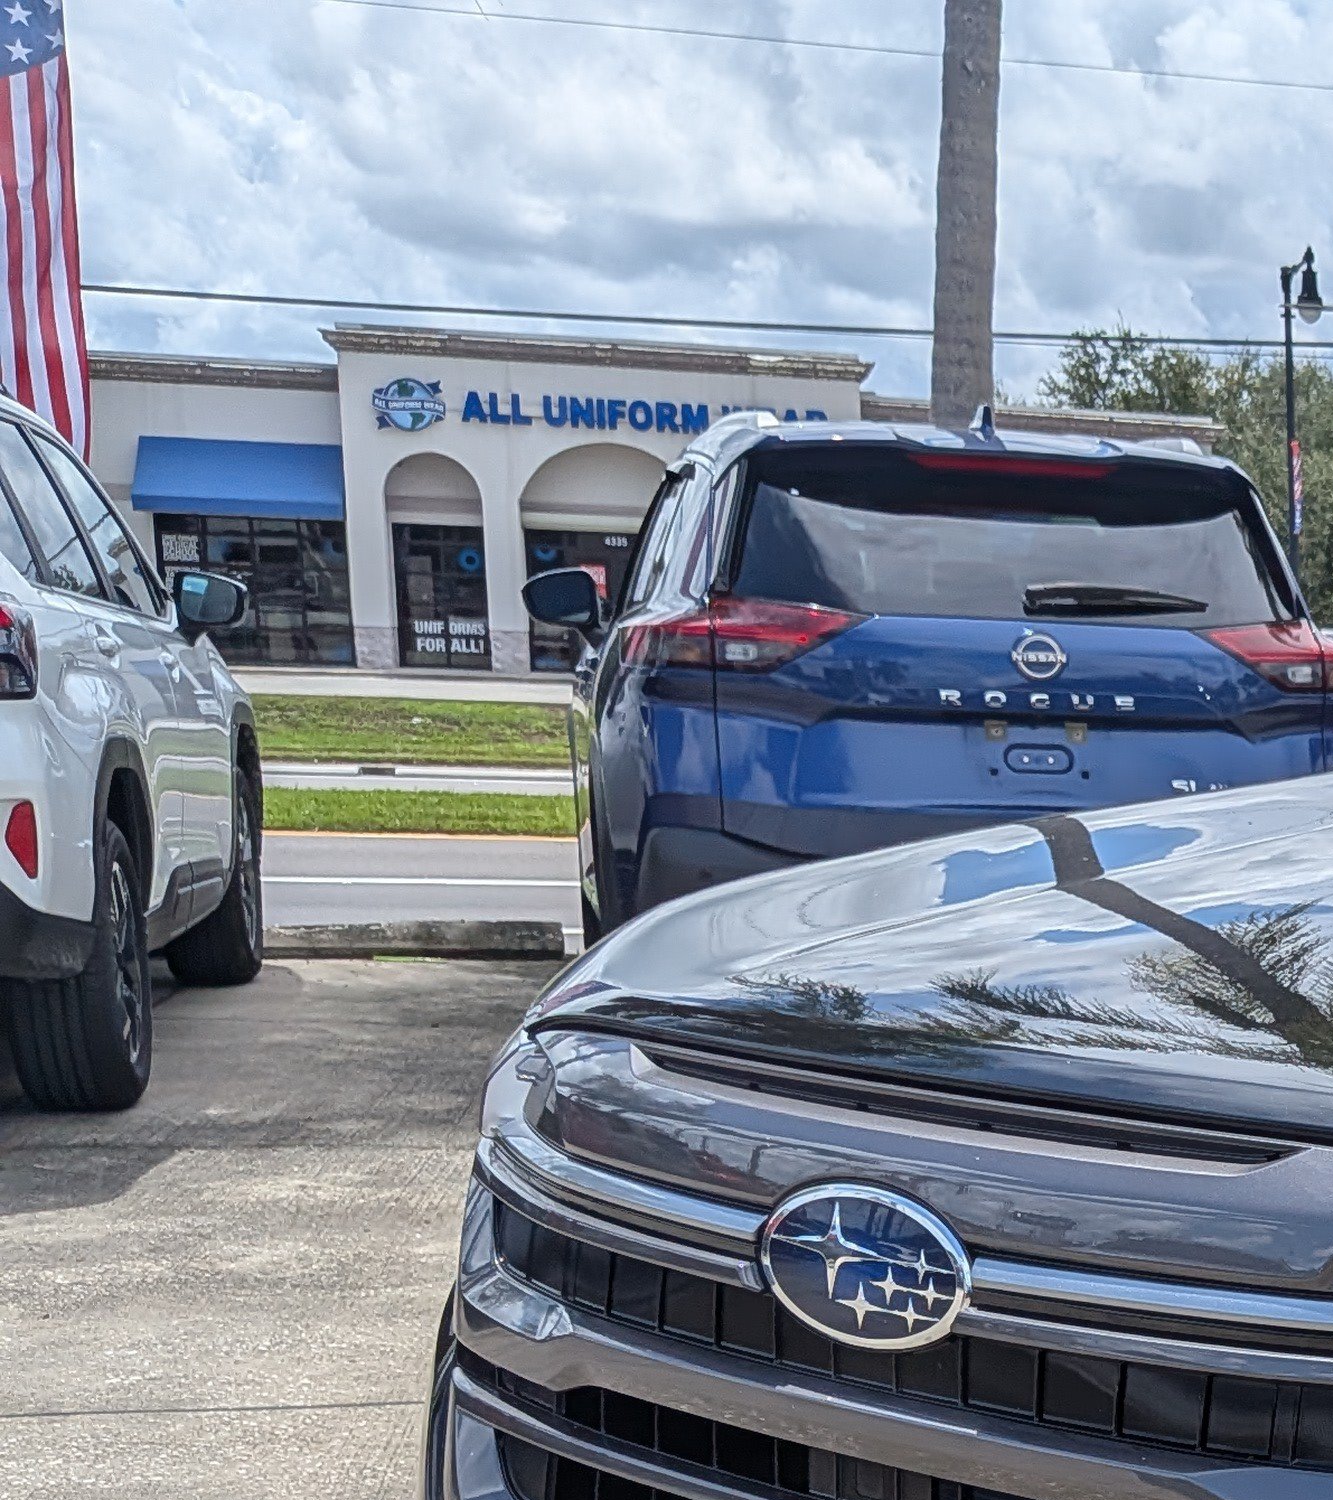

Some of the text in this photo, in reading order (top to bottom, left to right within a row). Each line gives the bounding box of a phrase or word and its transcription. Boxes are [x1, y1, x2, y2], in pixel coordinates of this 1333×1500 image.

[461, 390, 533, 426] ALL
[542, 395, 710, 434] UNIFORM
[416, 637, 446, 652] FOR
[1011, 650, 1067, 664] NISSAN
[938, 688, 1136, 712] ROGUE
